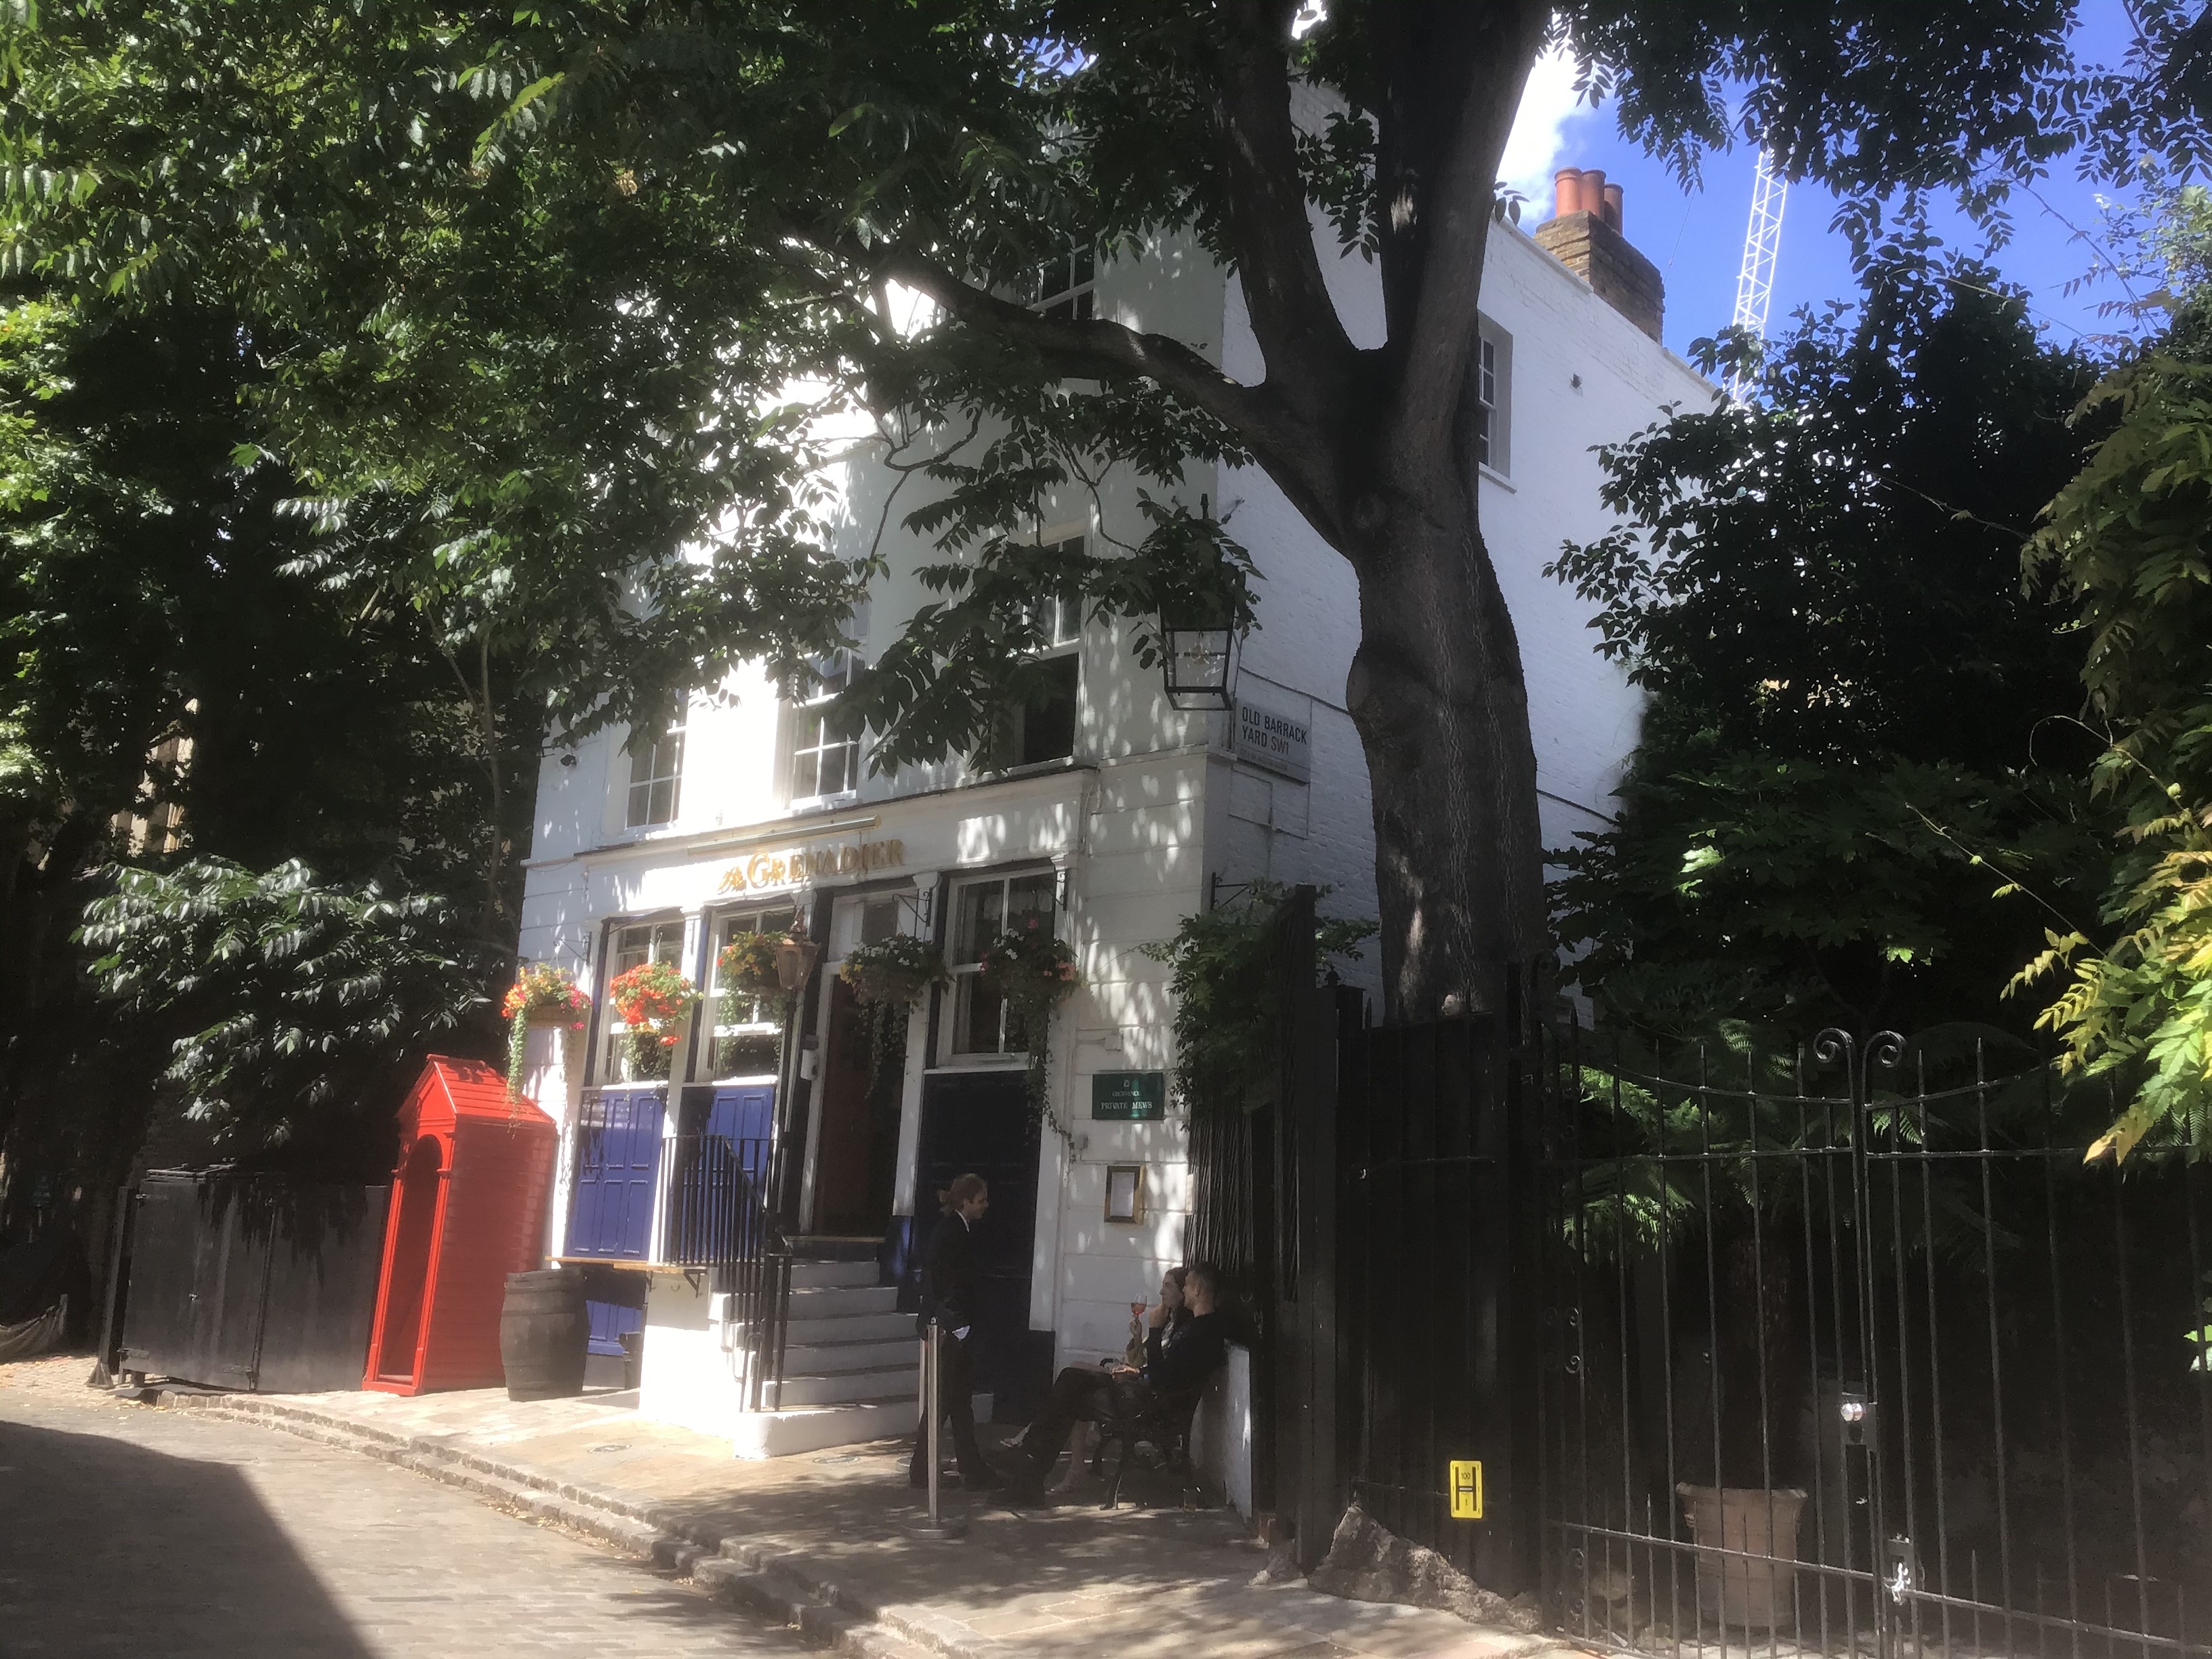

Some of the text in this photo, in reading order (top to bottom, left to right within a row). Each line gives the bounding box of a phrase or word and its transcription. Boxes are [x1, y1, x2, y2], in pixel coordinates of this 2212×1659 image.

[1242, 707, 1307, 745] OLD BARRACK
[1242, 725, 1289, 755] YARD SW1
[747, 839, 903, 888] GRENADIER
[1132, 1101, 1152, 1109] MEWS
